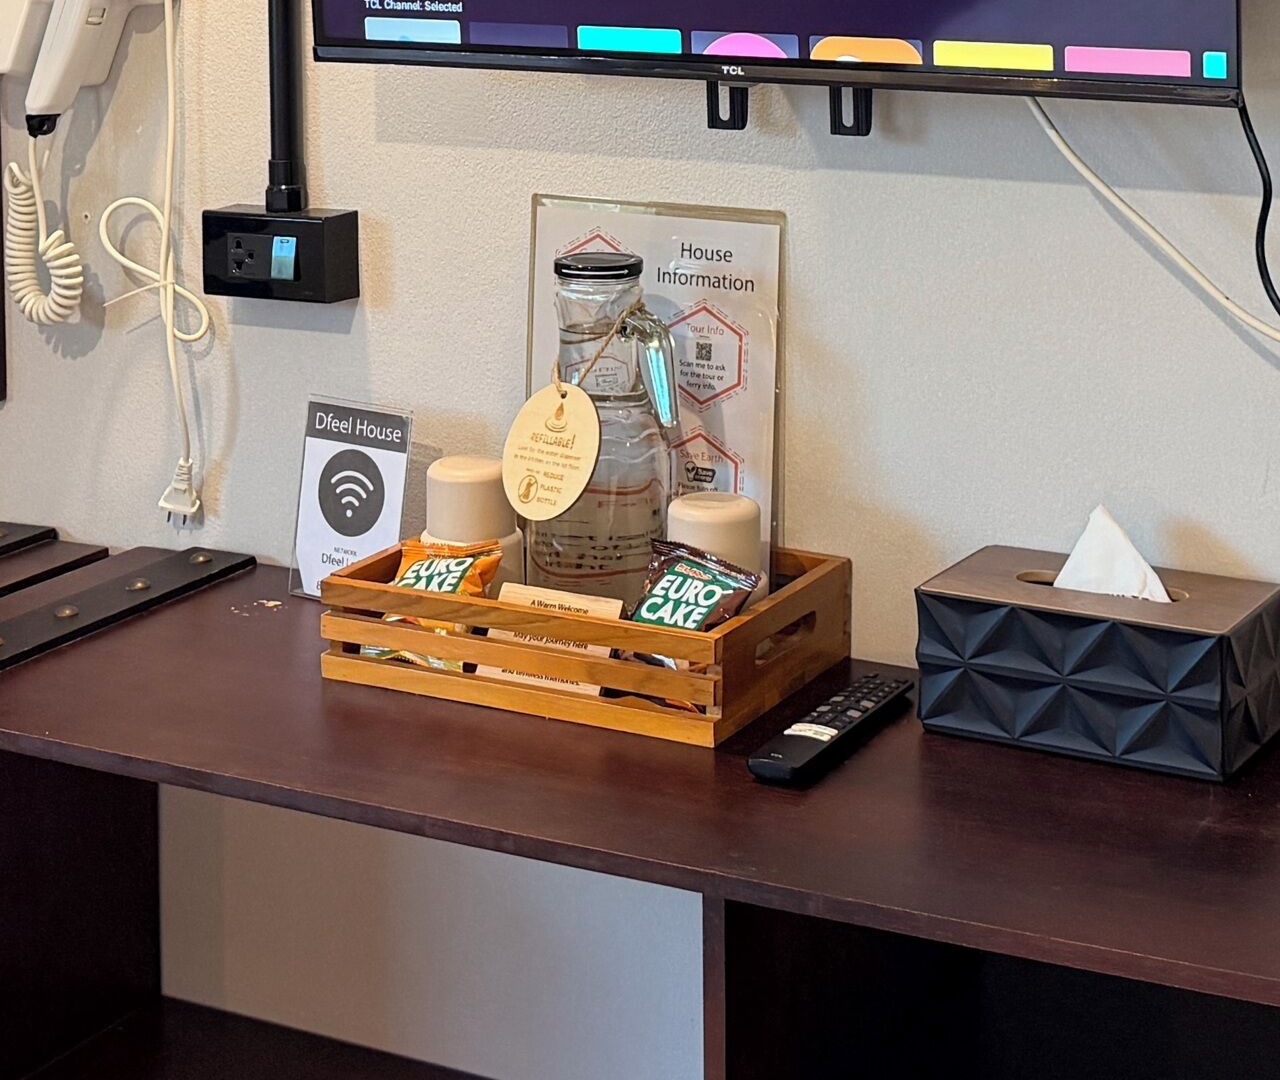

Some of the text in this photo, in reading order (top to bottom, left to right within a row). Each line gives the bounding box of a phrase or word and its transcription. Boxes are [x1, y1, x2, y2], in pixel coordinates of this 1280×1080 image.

[384, 0, 423, 11] Channel:
[424, 0, 463, 13] Selected
[721, 65, 745, 76] TCL
[680, 242, 733, 263] House
[656, 266, 755, 293] Information
[686, 323, 725, 336] Tour Info
[679, 359, 694, 368] Scan
[707, 362, 714, 370] to
[715, 363, 726, 371] ask
[680, 369, 689, 377] for
[702, 372, 716, 380] tour
[686, 380, 702, 391] ferry
[315, 412, 403, 443] Dfeel House
[701, 451, 724, 464] Earth
[321, 552, 345, 567] Dfeel
[403, 556, 474, 579] EURO
[651, 574, 726, 607] EURO
[537, 600, 557, 609] Warm
[558, 603, 589, 615] Welcome
[640, 596, 709, 629] CAKE
[513, 631, 589, 650] May your journey here
